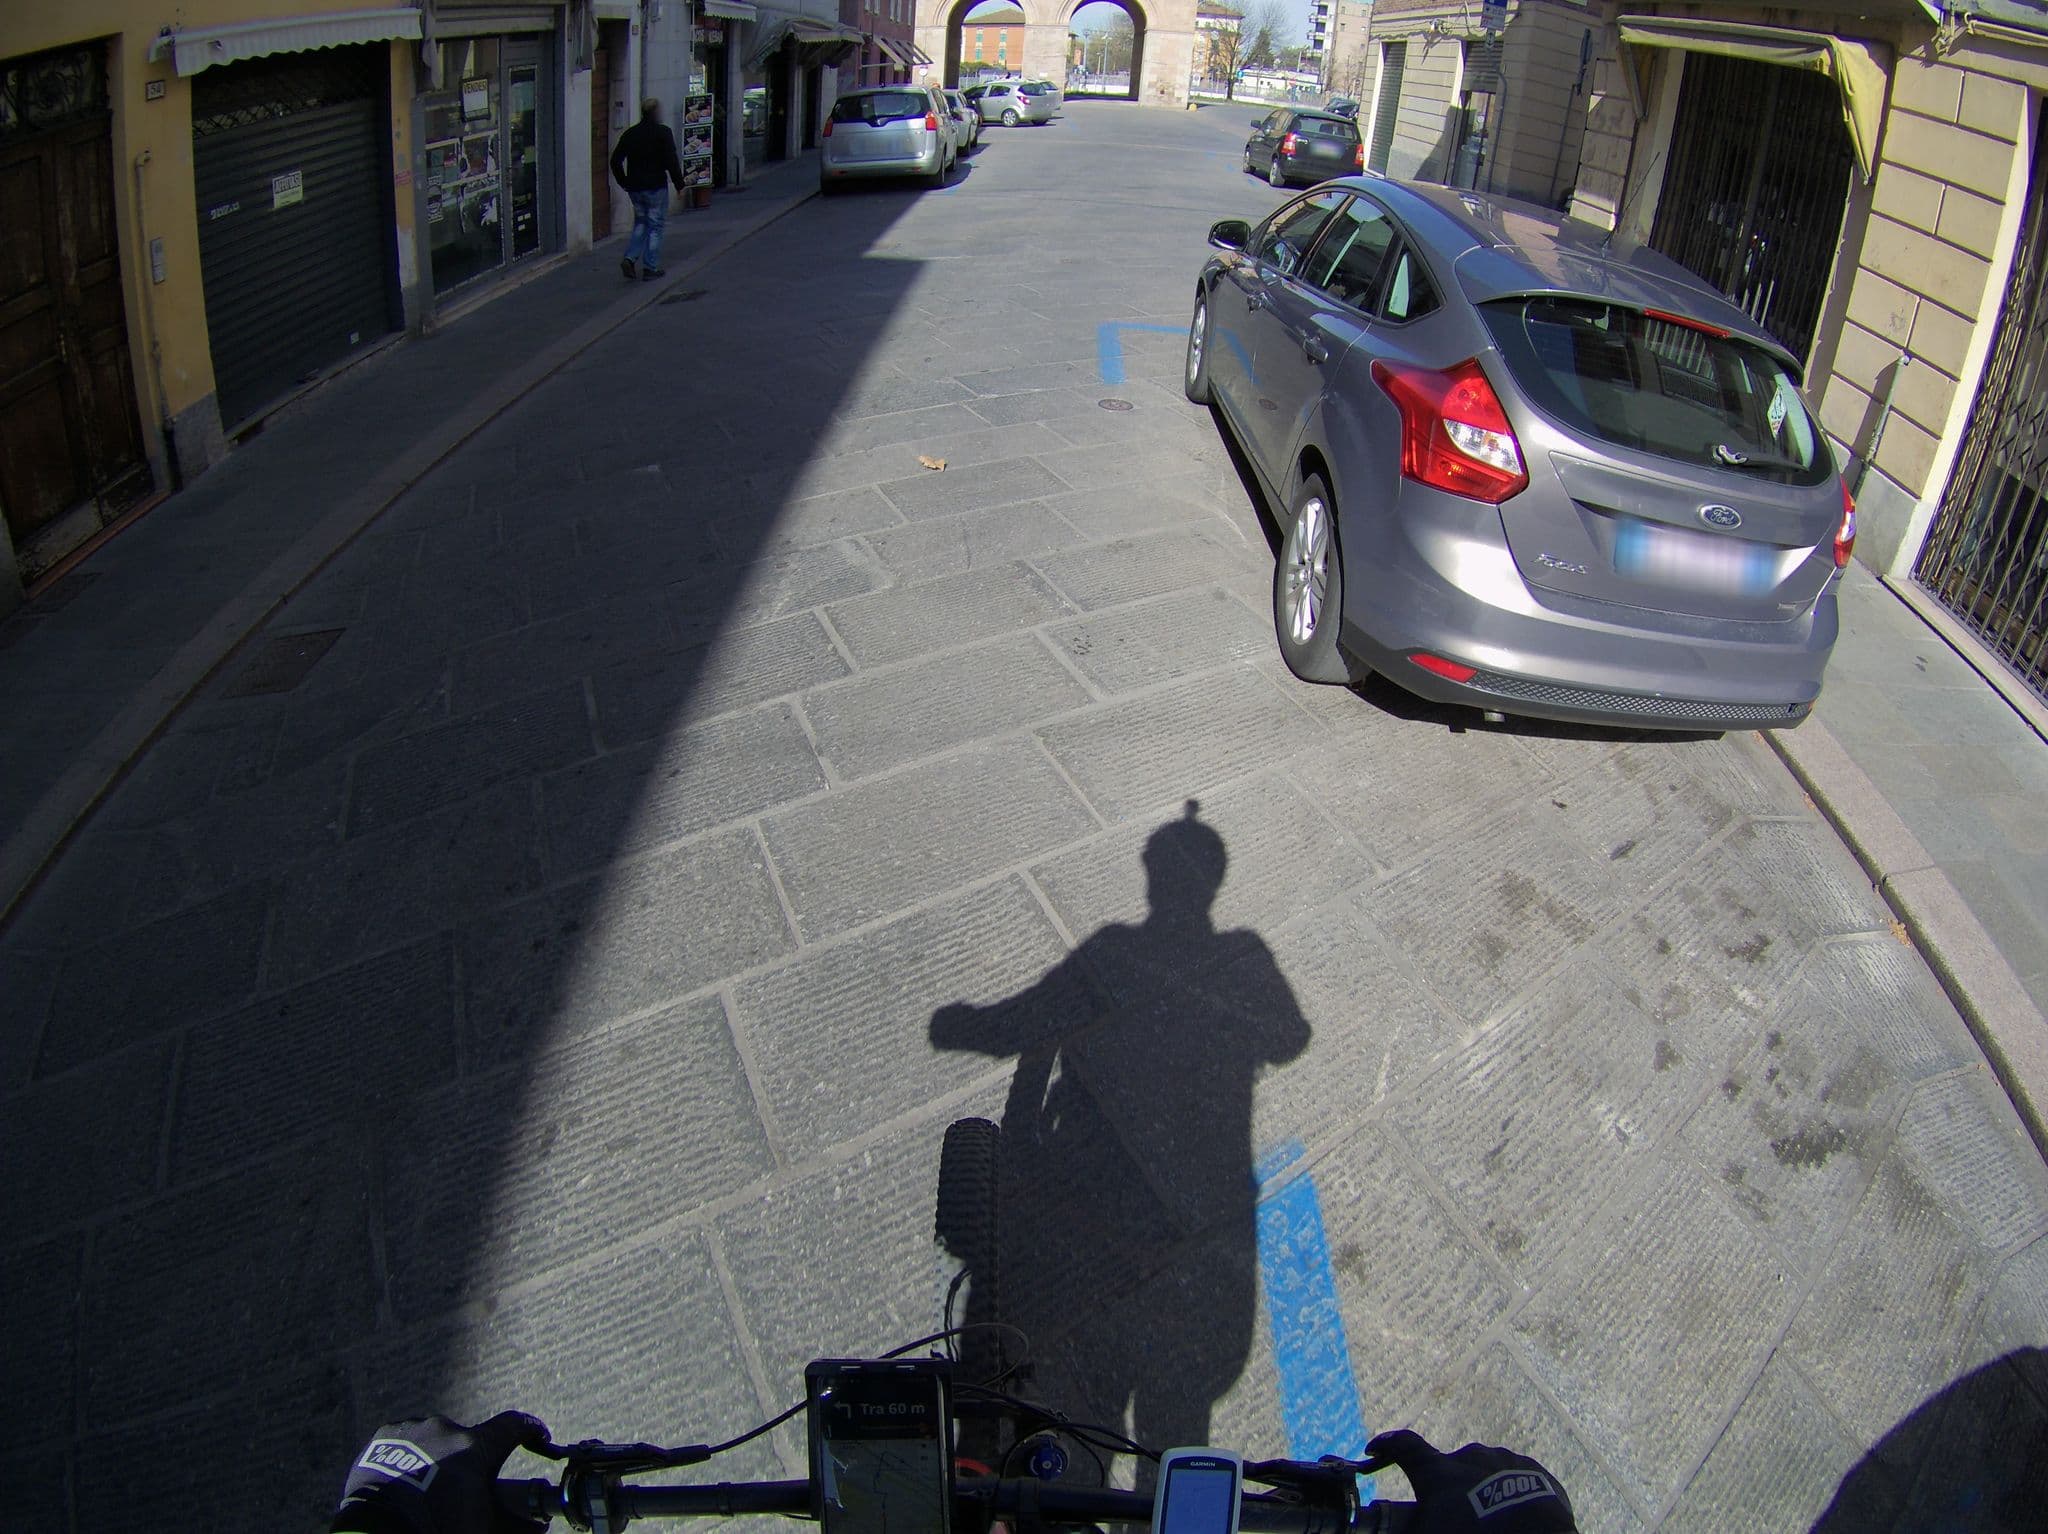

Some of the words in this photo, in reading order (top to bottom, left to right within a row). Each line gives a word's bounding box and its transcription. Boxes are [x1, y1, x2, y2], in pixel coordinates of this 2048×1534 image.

[1710, 508, 1735, 525] Ford
[861, 1402, 885, 1415] Tra
[888, 1402, 907, 1415] 60
[910, 1404, 926, 1415] m
[1484, 1475, 1540, 1506] 100%
